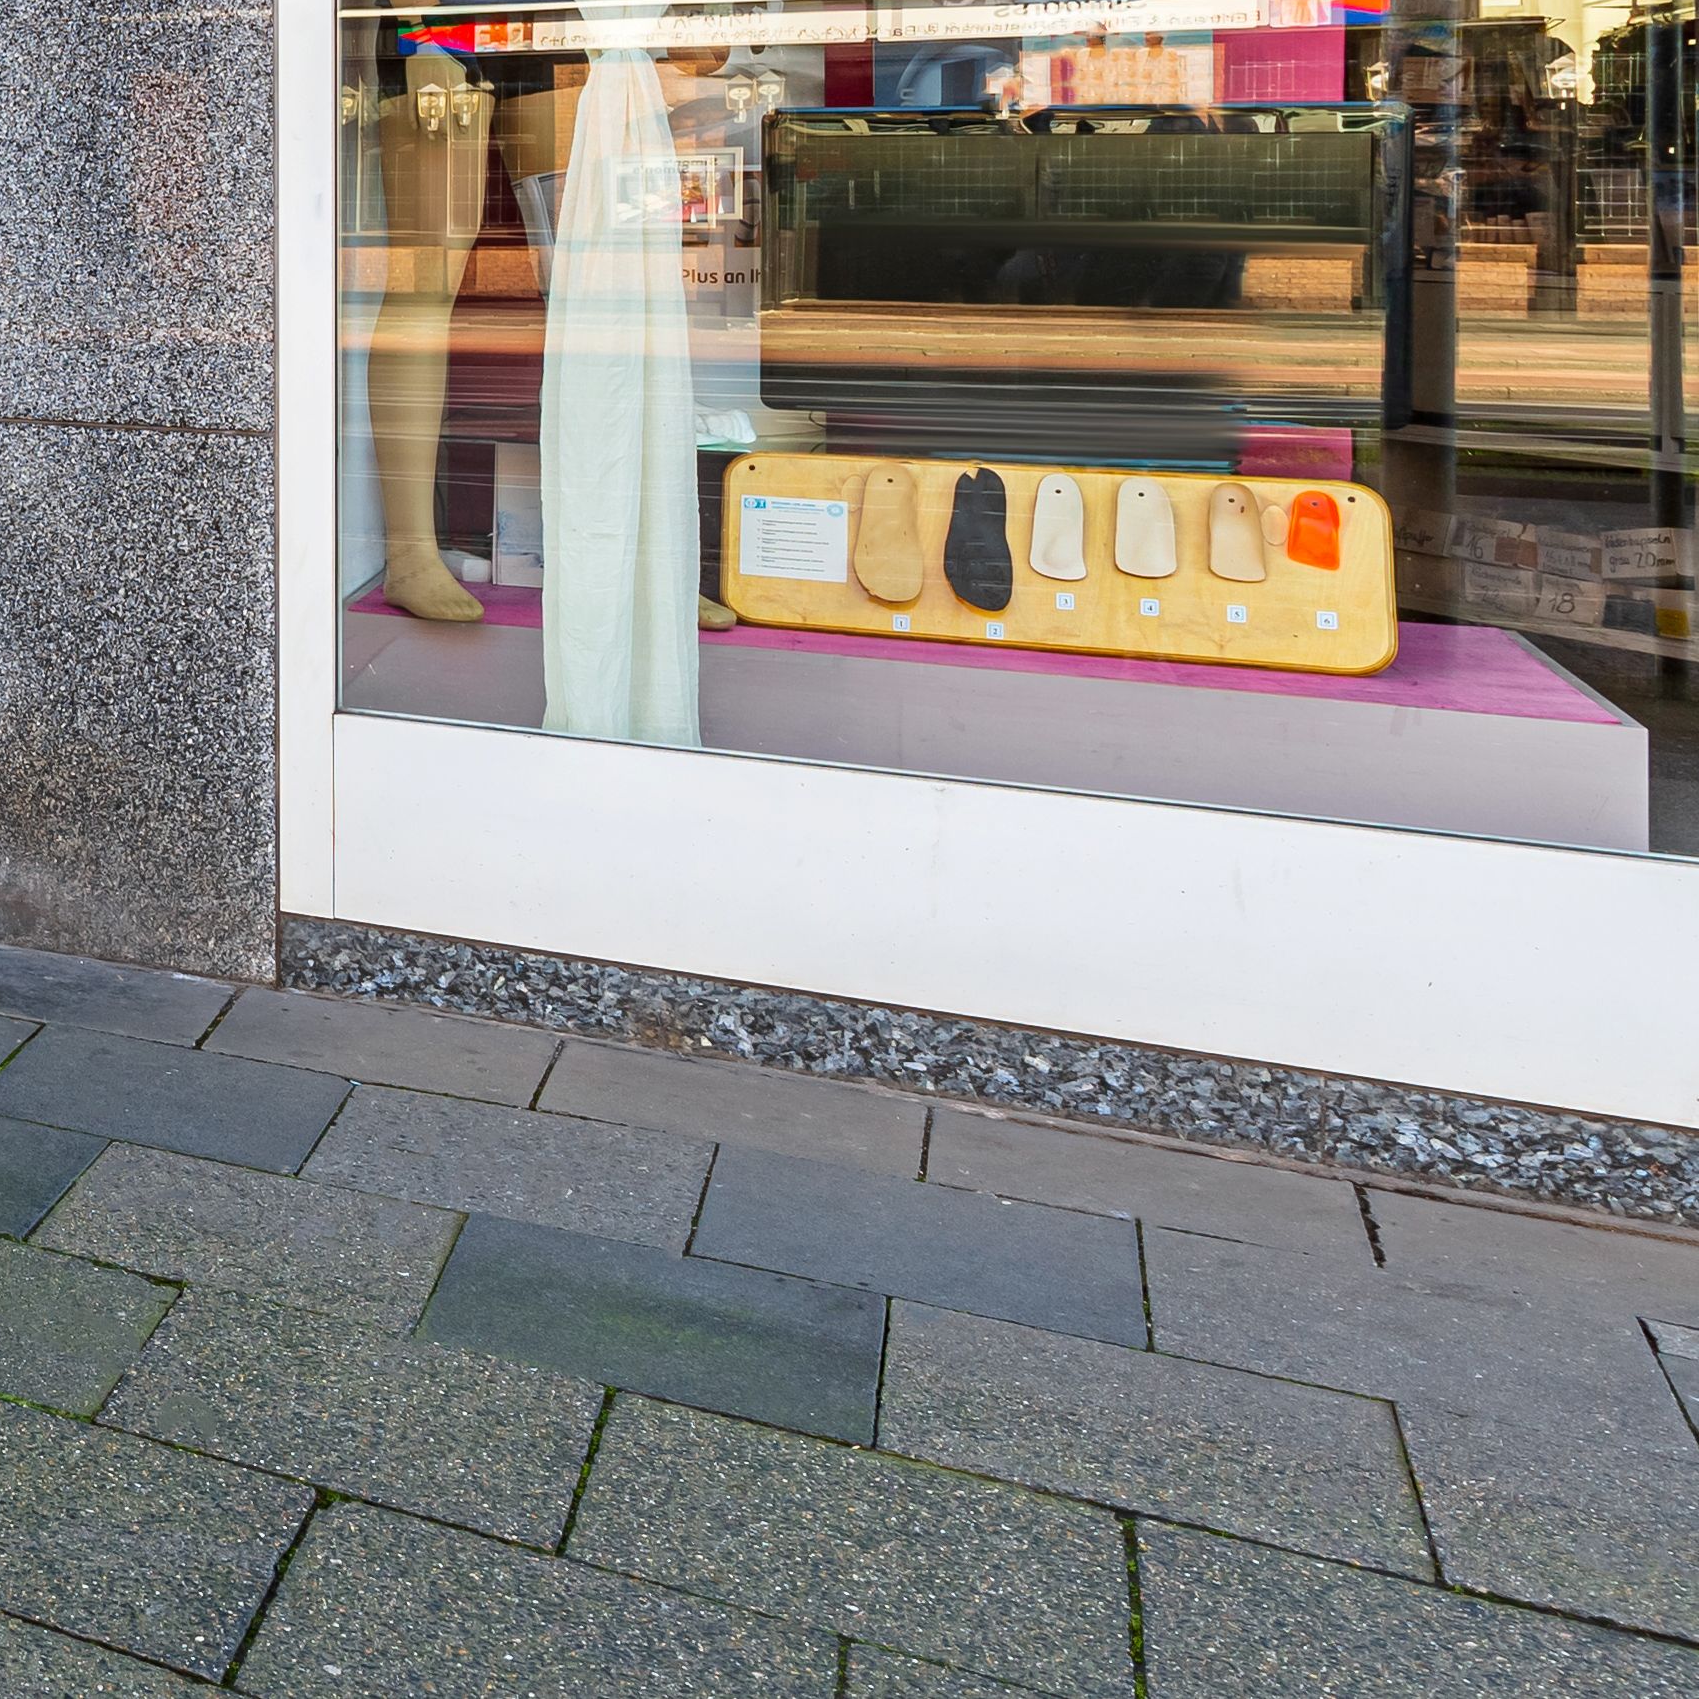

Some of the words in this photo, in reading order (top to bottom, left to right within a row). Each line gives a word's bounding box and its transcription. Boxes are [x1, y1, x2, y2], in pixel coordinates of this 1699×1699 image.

[682, 268, 718, 284] Plus
[724, 270, 746, 284] an
[1548, 592, 1575, 614] 18
